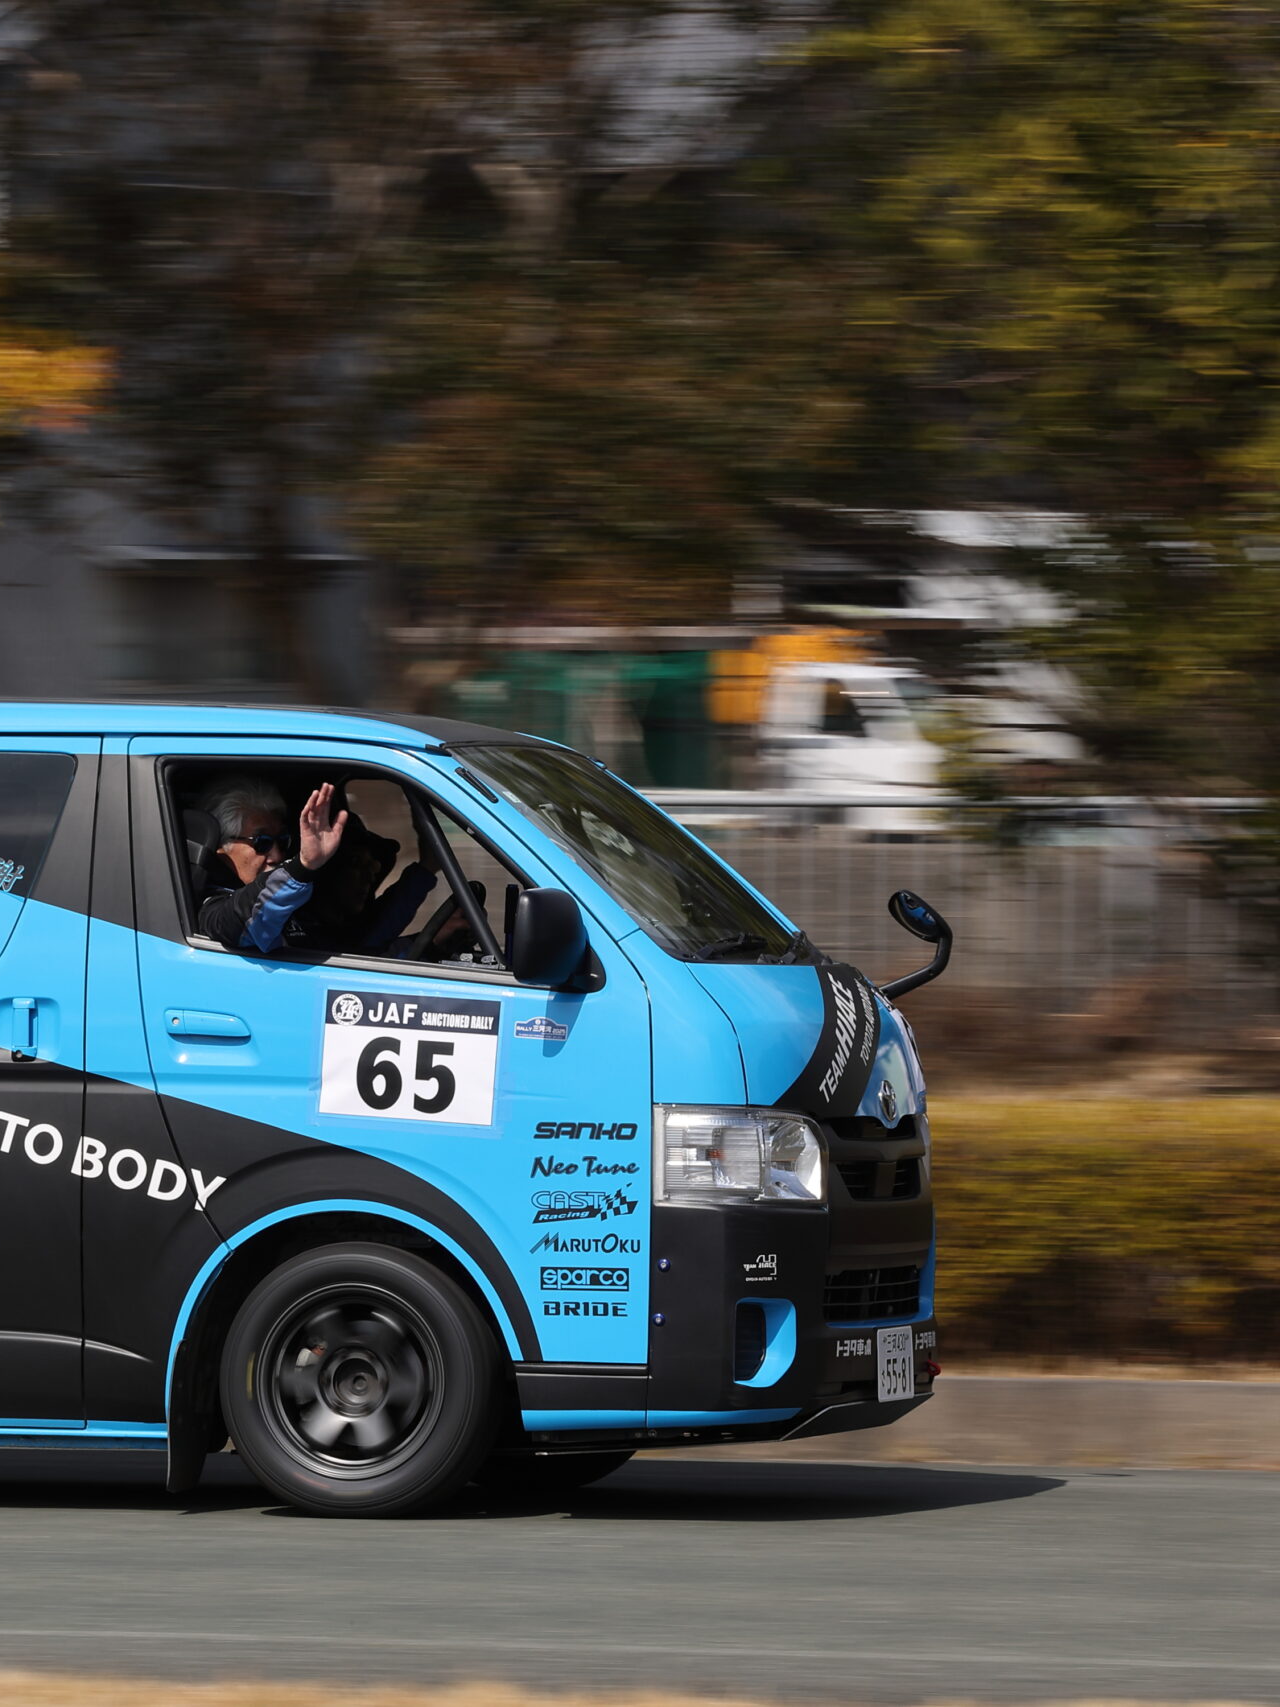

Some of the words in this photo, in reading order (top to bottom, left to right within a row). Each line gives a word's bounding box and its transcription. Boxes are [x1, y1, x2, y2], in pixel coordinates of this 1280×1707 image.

[368, 1001, 418, 1025] JAF
[421, 1011, 470, 1028] SANCTIONED
[470, 1015, 494, 1030] RALLY
[827, 972, 857, 1049] HIACE
[356, 1036, 456, 1114] 65
[819, 1045, 850, 1103] TEAM
[533, 1121, 638, 1141] SANKO
[70, 1136, 226, 1211] BODY
[530, 1155, 578, 1178] Neo
[581, 1156, 640, 1177] Tune
[530, 1190, 606, 1210] CAST
[538, 1210, 590, 1221] Racing
[542, 1268, 628, 1290] sparco
[543, 1301, 628, 1317] BRIDE
